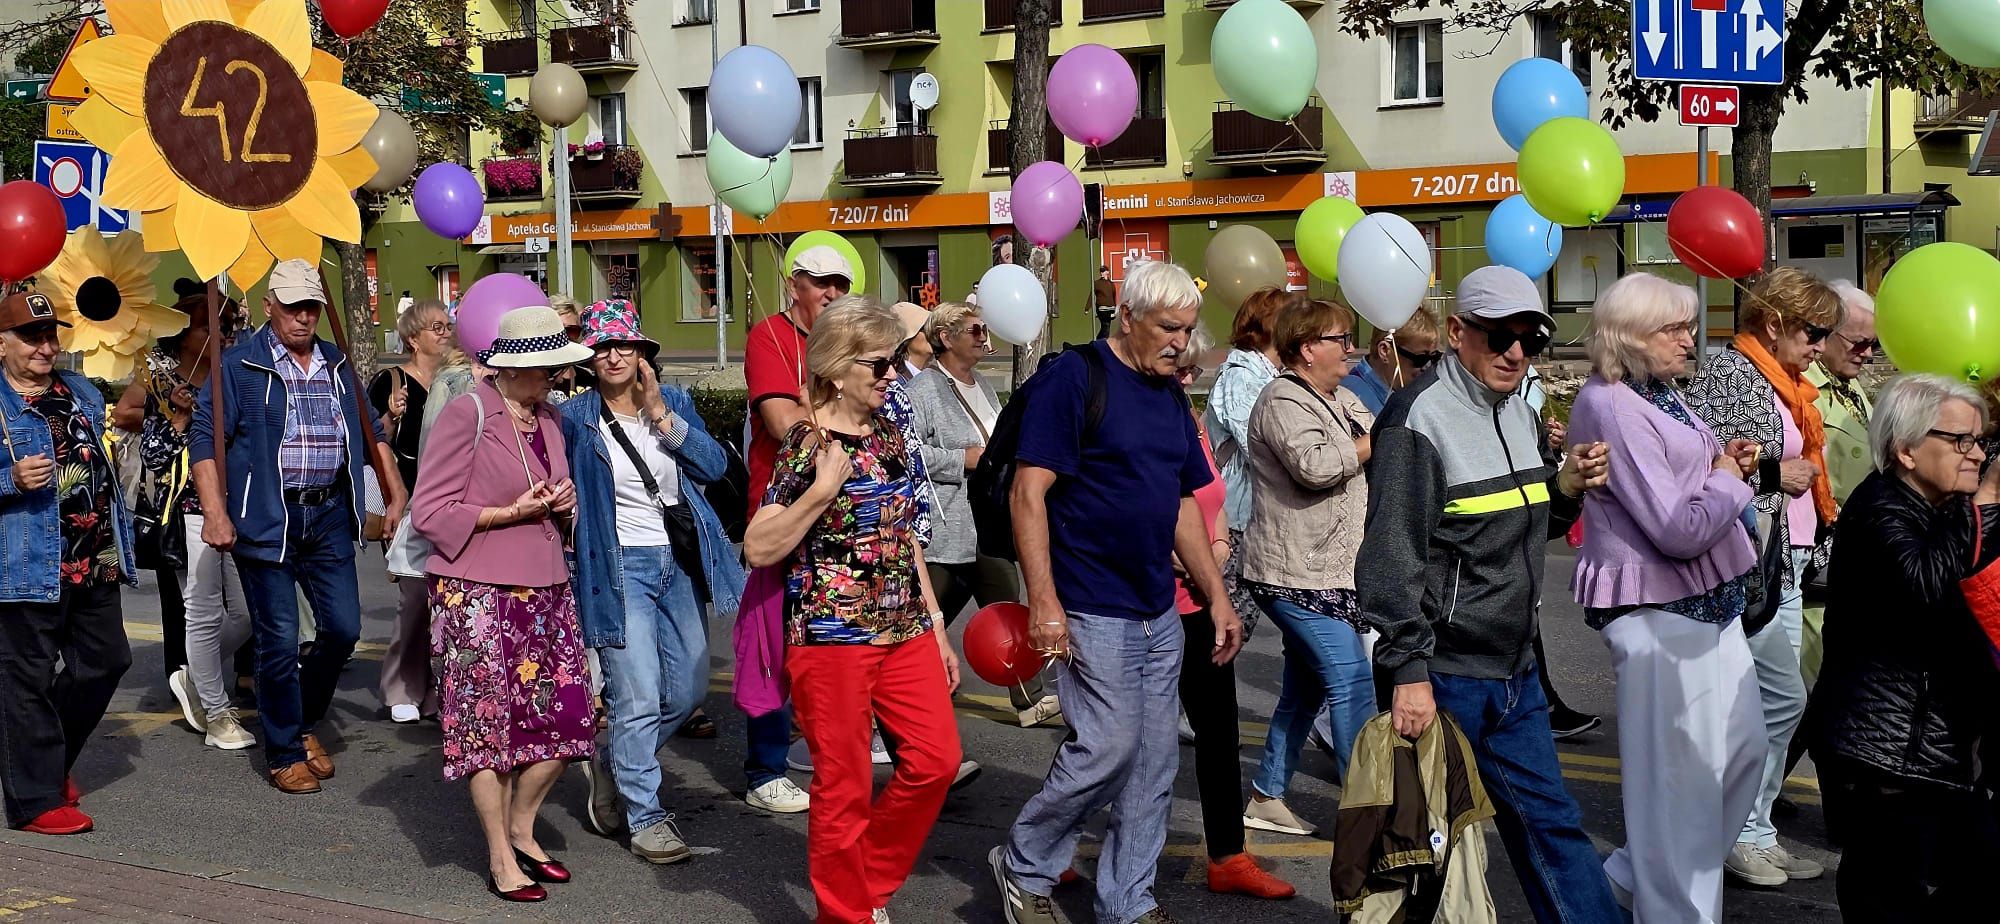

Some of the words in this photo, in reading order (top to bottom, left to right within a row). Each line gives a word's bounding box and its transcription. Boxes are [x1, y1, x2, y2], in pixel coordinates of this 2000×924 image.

[916, 81, 932, 89] nc+
[180, 56, 291, 162] 42
[1690, 93, 1710, 117] 60
[1410, 174, 1480, 197] 7-20/7
[1215, 192, 1265, 207] Jachowicza
[829, 205, 878, 225] 7-20/7
[883, 203, 909, 222] dni
[507, 222, 540, 239] Apteka
